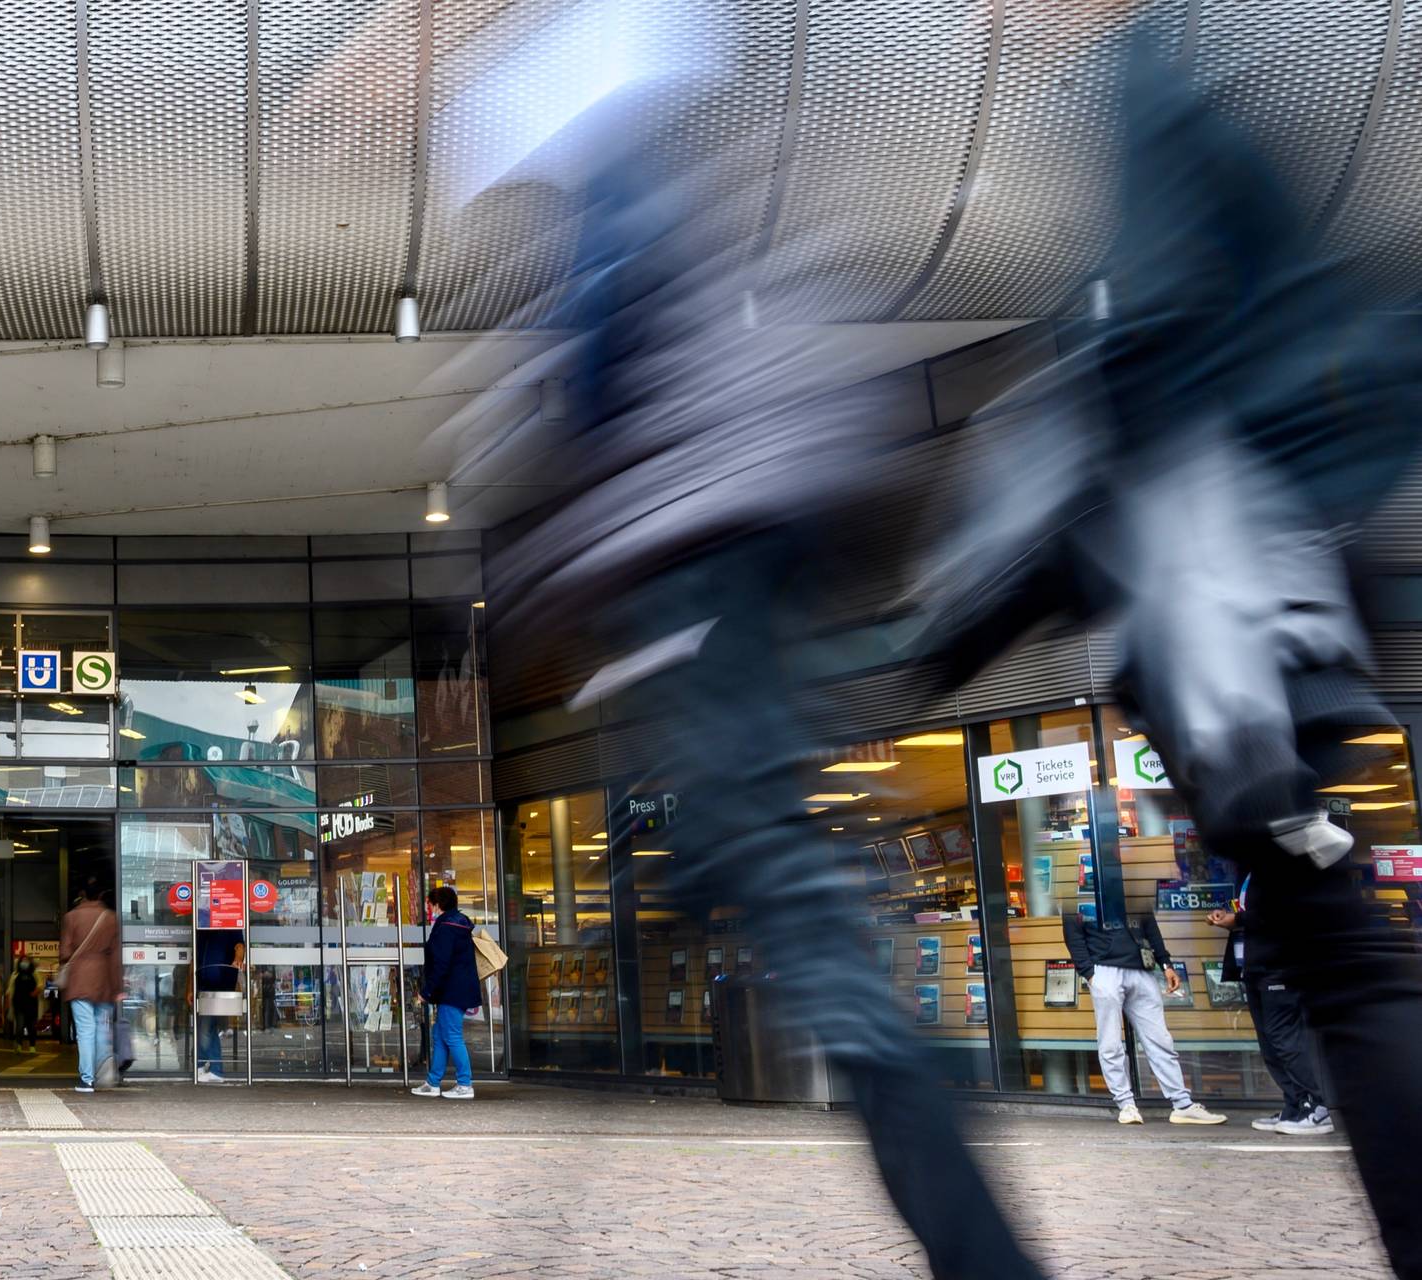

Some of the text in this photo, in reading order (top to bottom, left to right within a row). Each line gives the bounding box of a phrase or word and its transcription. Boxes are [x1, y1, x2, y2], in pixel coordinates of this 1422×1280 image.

[28, 657, 51, 686] U
[81, 657, 107, 688] S
[1035, 759, 1074, 774] Tickets
[1142, 760, 1163, 769] VRR
[1000, 772, 1016, 781] VRR
[1036, 771, 1075, 784] Service
[629, 799, 656, 814] Press
[30, 942, 60, 951] Ticket
